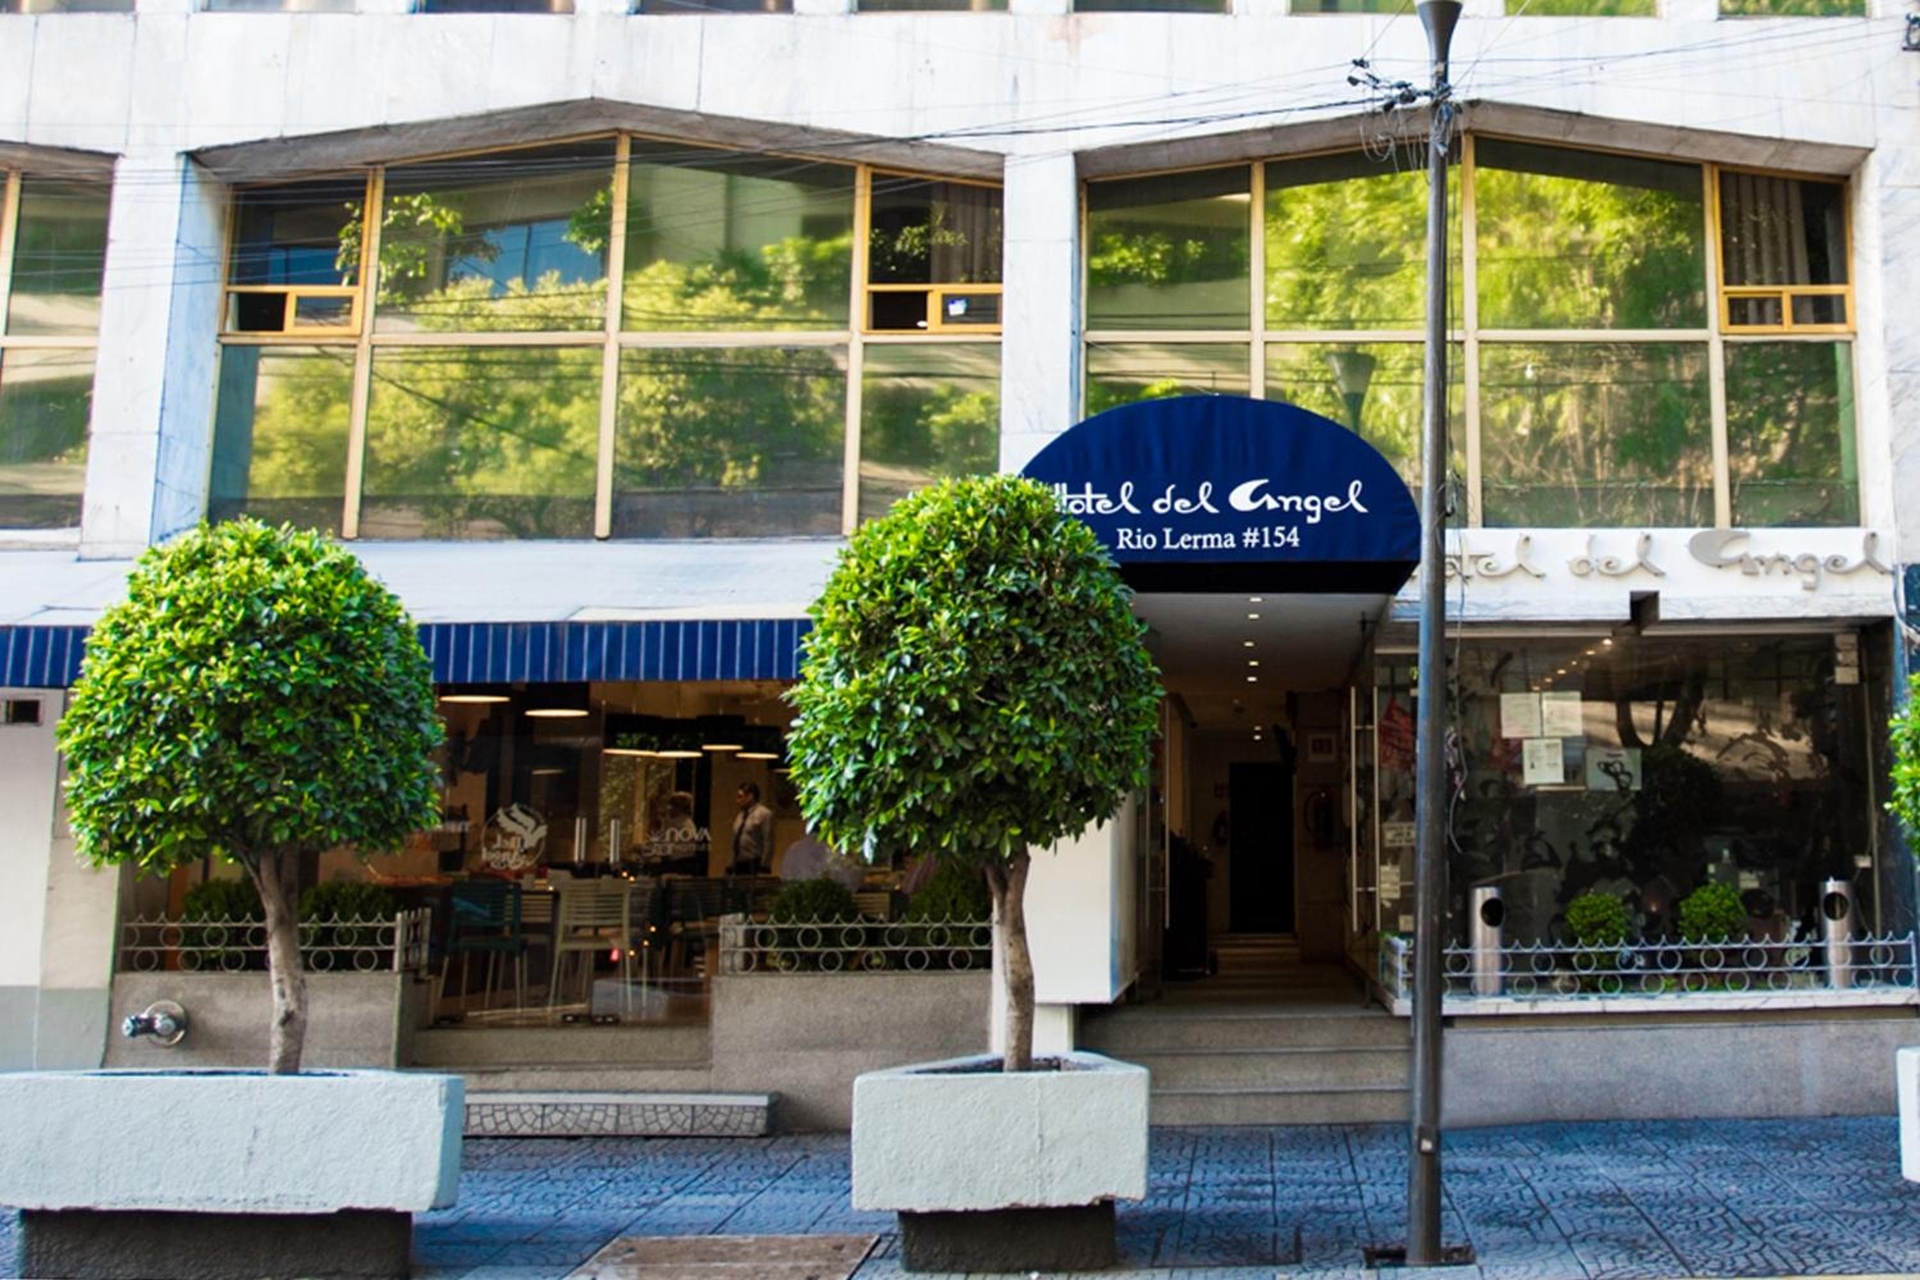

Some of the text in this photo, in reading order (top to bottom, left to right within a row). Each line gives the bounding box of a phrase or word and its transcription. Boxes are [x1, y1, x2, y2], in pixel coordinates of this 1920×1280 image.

[1053, 478, 1370, 524] Hotel del Angel
[1116, 525, 1301, 550] Rio Lerma #154
[1445, 530, 1895, 590] otel del Angel
